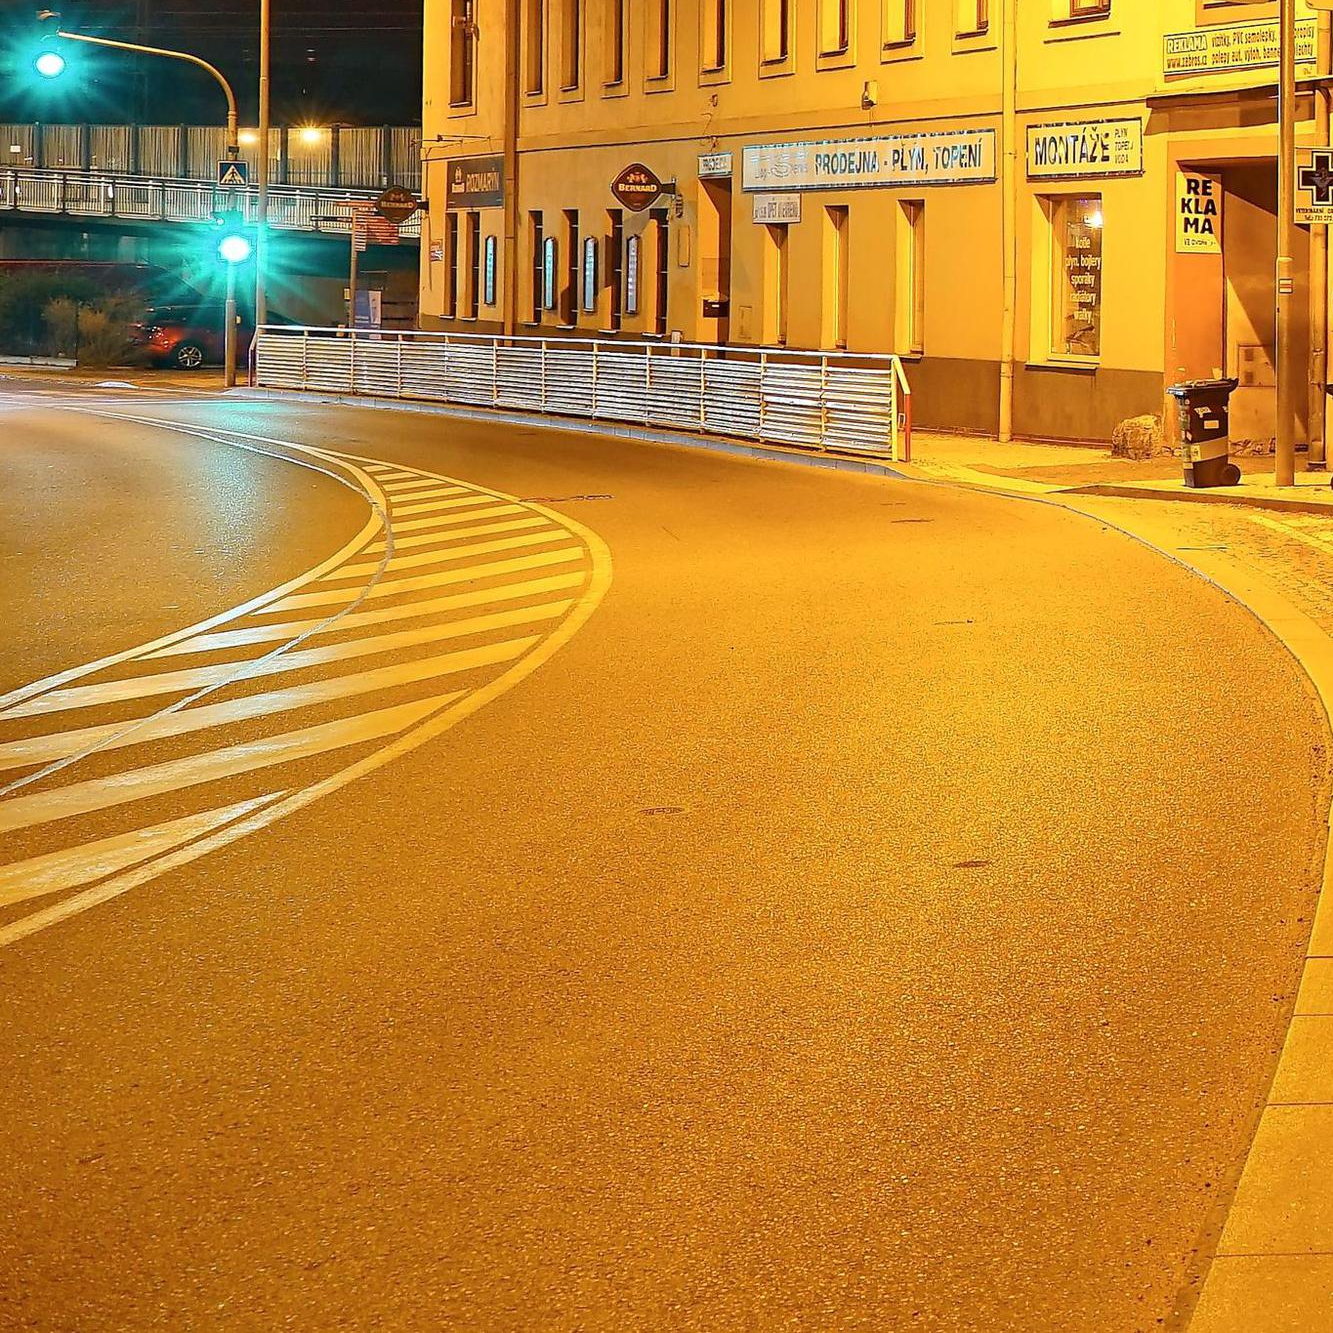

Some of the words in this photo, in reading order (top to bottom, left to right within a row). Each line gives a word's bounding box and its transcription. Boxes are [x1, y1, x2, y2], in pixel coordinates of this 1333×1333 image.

[1166, 35, 1208, 54] REKLAMA
[1034, 127, 1110, 166] MONTÁŽE
[814, 146, 879, 176] PRODEJNA
[933, 138, 983, 169] TOPENÍ
[618, 183, 657, 193] BERNARD
[1187, 178, 1213, 196] RE
[1180, 197, 1217, 216] KLA
[1183, 217, 1214, 235] MA
